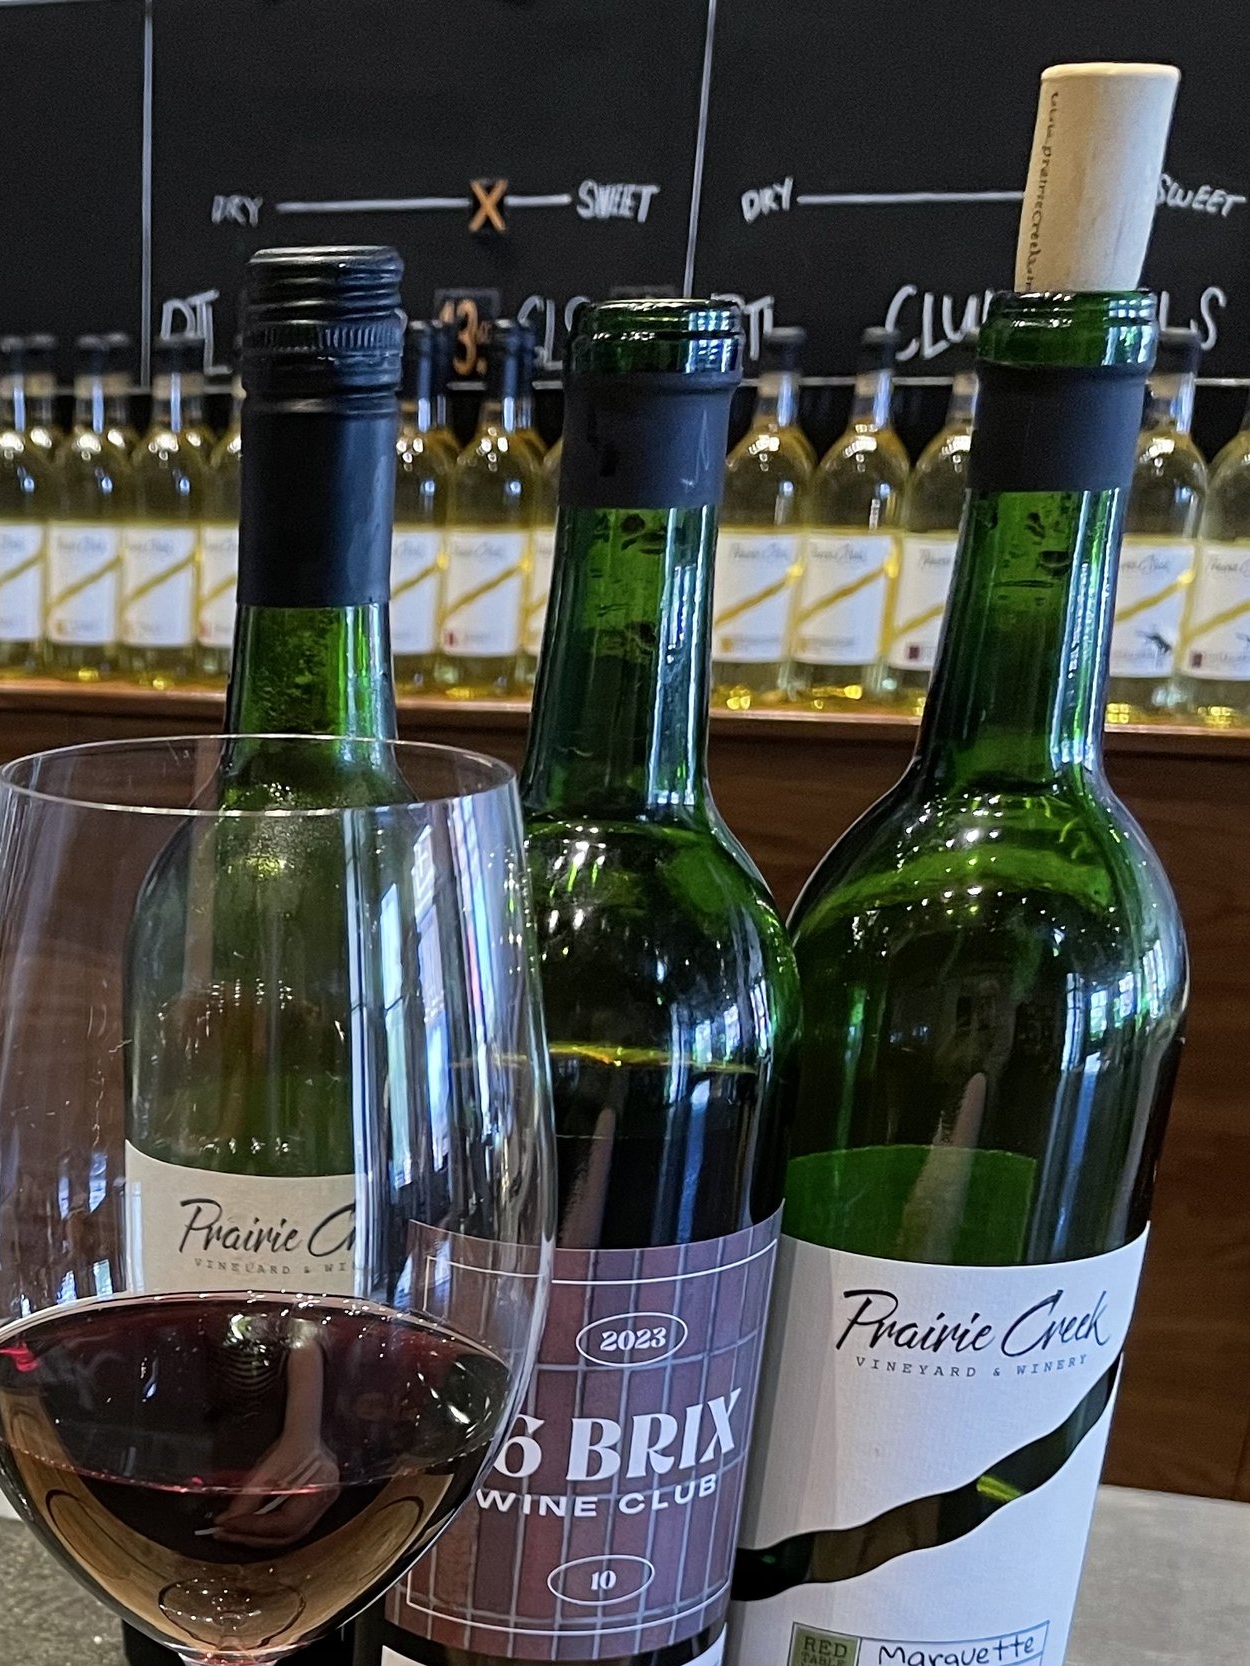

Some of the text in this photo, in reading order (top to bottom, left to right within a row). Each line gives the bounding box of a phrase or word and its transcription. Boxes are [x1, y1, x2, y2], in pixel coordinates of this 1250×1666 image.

[211, 193, 262, 227] DRY
[576, 179, 660, 223] SWEET
[741, 176, 793, 223] DRY
[1155, 172, 1247, 218] SWEET
[178, 1197, 302, 1254] Prairie
[599, 1326, 668, 1352] 2023
[835, 1289, 1110, 1358] Prairie Creek
[856, 1352, 1088, 1378] VINEYARD & WINERY
[565, 1386, 742, 1481] BRIX
[475, 1473, 718, 1518] WINE CLUB
[590, 1570, 617, 1590] 10
[803, 1635, 848, 1658] RED
